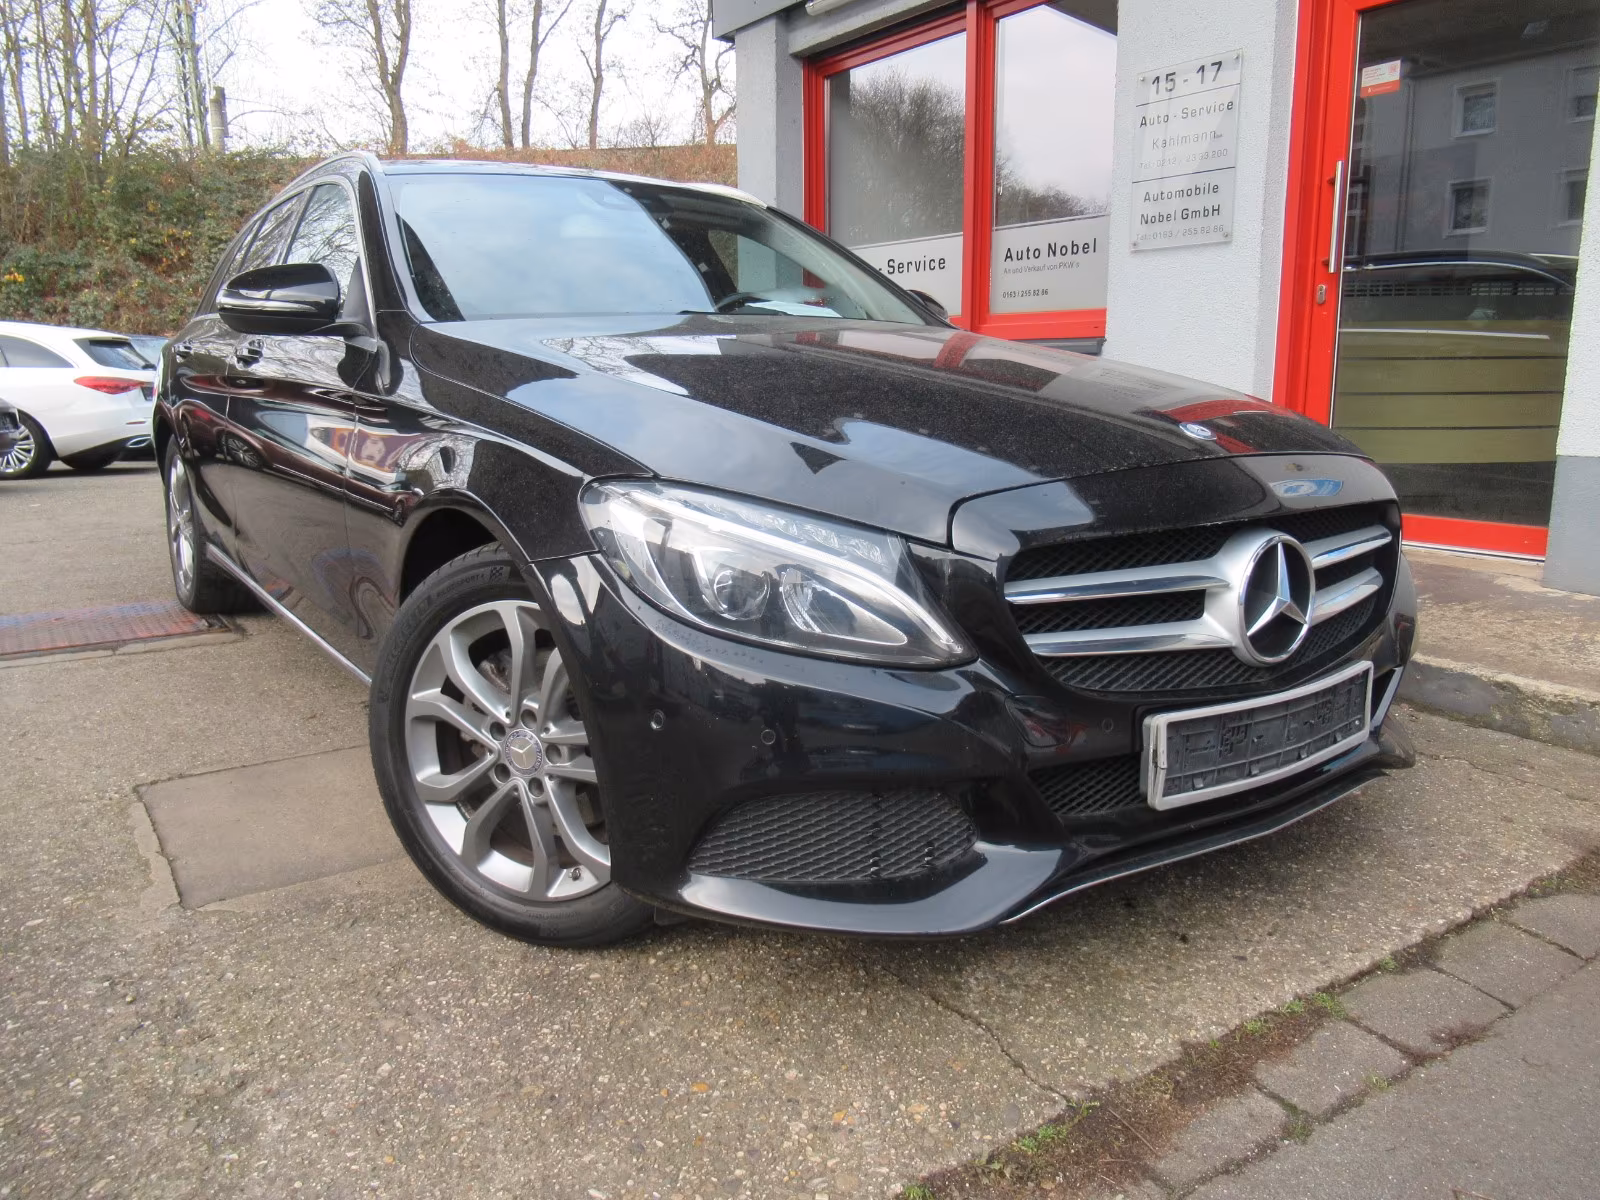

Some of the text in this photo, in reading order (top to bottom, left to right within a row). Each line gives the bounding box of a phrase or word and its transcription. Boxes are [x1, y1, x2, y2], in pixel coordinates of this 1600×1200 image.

[1152, 72, 1176, 95] 15
[1196, 60, 1223, 85] 17
[1139, 112, 1169, 128] Auto
[1181, 100, 1234, 120] Service
[1152, 129, 1216, 150] Kahlmann
[1143, 182, 1220, 203] Automobile
[1140, 204, 1220, 225] Nobel GmbH
[1004, 238, 1097, 263] Auto Nobel
[887, 255, 947, 275] Service
